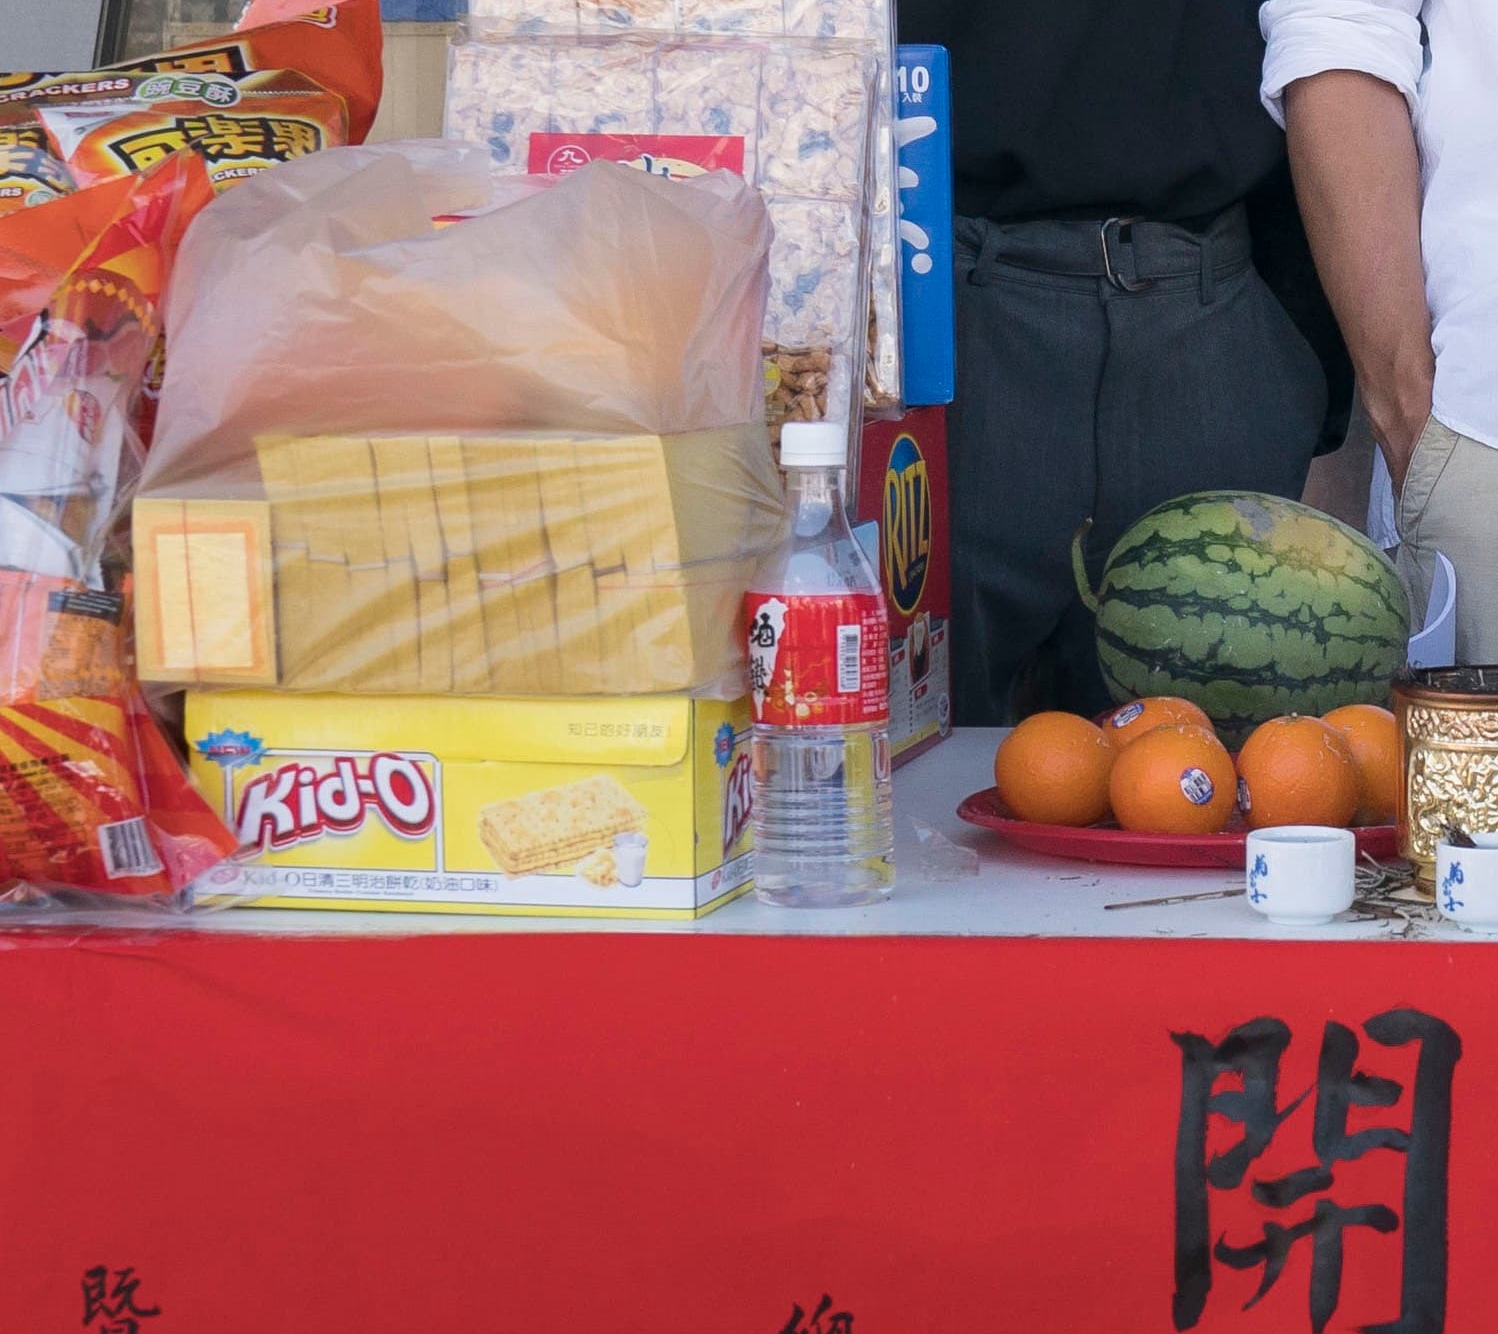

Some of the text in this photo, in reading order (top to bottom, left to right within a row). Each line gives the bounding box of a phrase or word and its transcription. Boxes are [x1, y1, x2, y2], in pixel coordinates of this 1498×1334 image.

[143, 78, 236, 105] 豌豆酥
[897, 66, 930, 93] 10
[885, 458, 929, 593] RITZ
[235, 754, 433, 852] Kid-O
